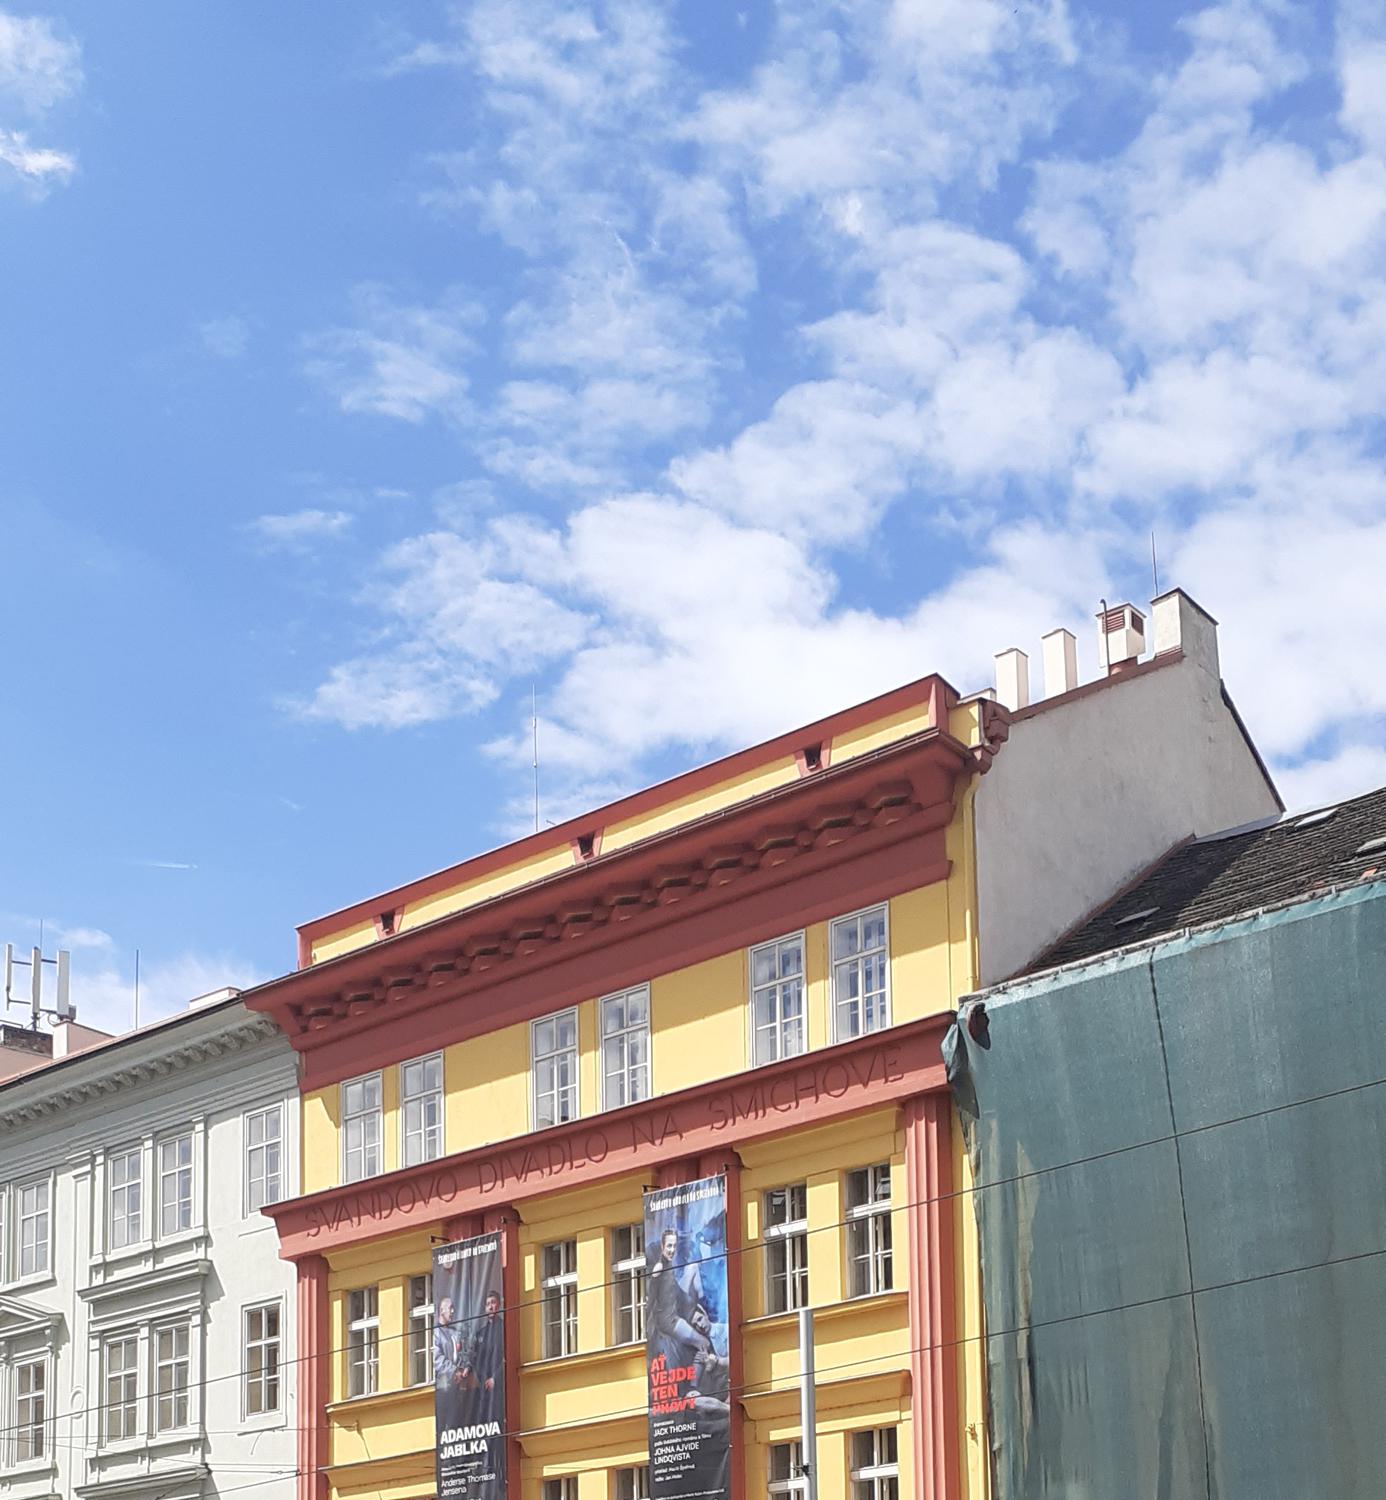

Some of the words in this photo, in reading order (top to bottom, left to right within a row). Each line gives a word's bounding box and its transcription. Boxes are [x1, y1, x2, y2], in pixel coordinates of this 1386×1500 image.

[477, 1131, 609, 1194] DIVADLO
[631, 1110, 684, 1154] NA
[650, 1353, 666, 1373] AŤ
[651, 1365, 697, 1387] VEJDE
[651, 1383, 679, 1401] TEN
[440, 1421, 501, 1445] ADAMOVA
[653, 1426, 669, 1438] JACK
[669, 1422, 697, 1434] THORNE
[440, 1439, 488, 1460] JABLKA
[653, 1445, 675, 1456] JOHNA
[675, 1441, 700, 1452] AJVIDE
[654, 1452, 691, 1465] LINDQVISTA
